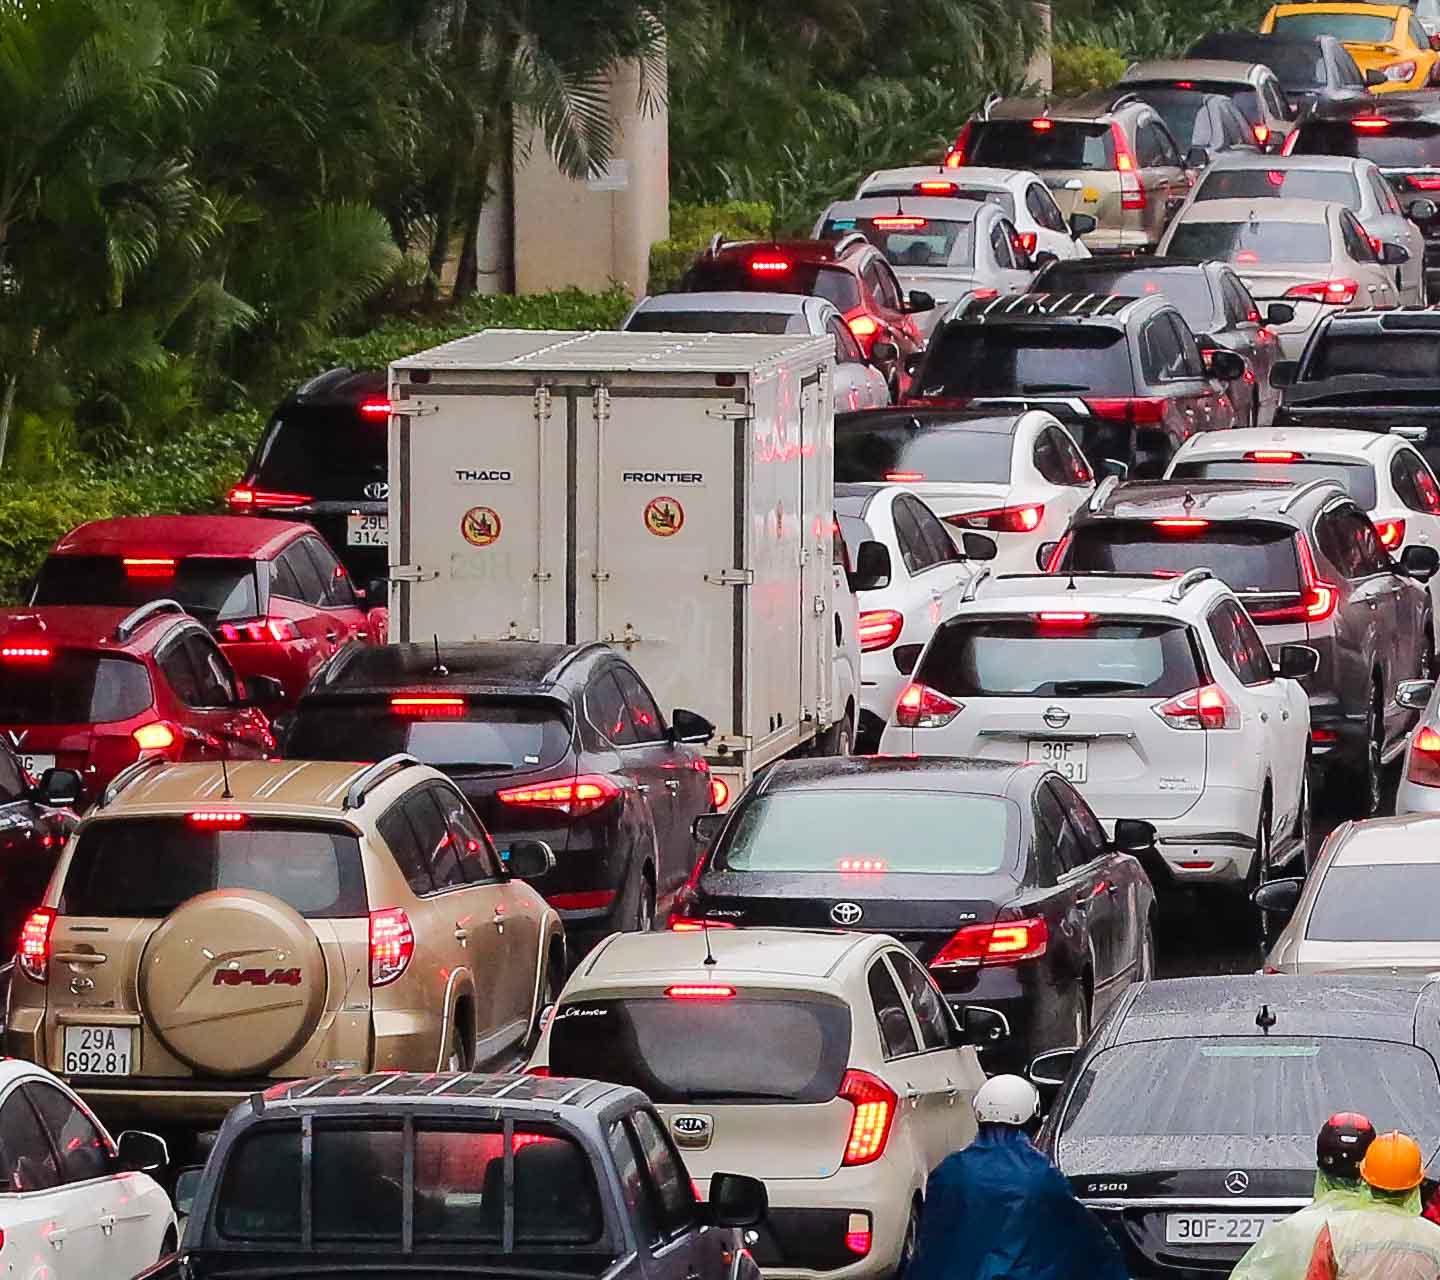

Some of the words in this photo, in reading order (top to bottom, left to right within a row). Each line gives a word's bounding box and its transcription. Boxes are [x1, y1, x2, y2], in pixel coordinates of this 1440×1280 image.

[456, 471, 511, 481] THACO
[623, 473, 703, 483] FRONTIER
[213, 968, 302, 986] RAV4
[80, 1028, 116, 1050] 29A
[65, 1052, 128, 1074] 692.81
[679, 1119, 701, 1129] KIA
